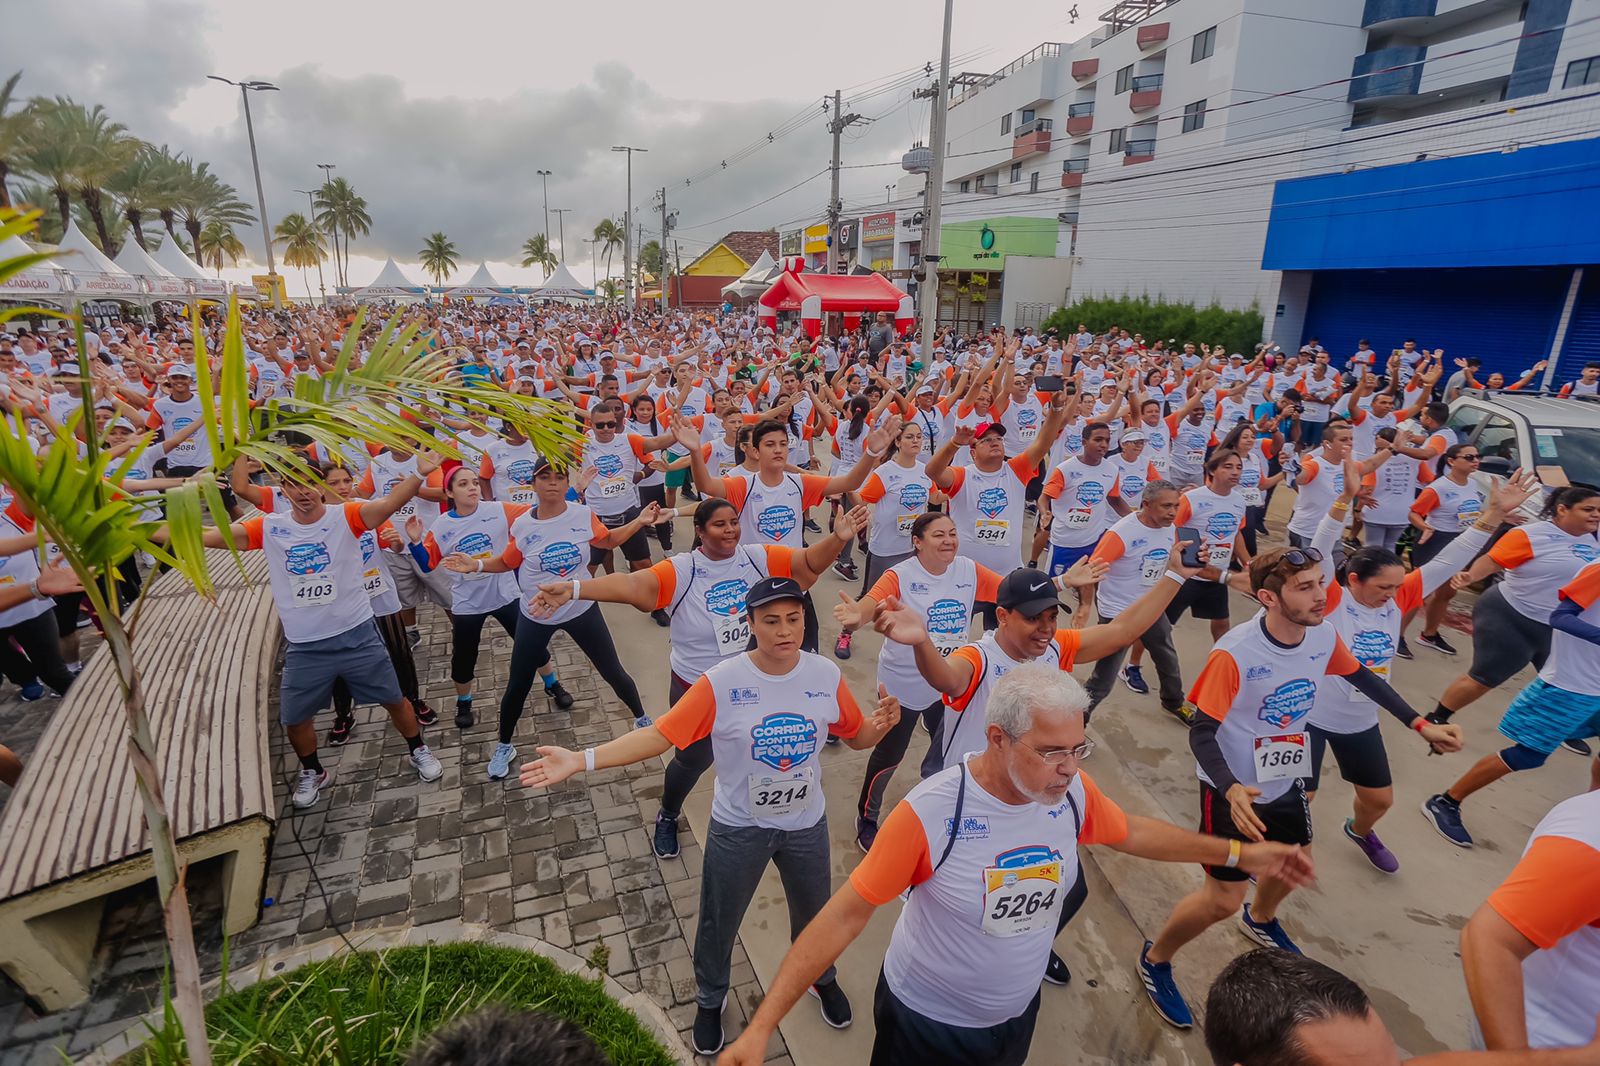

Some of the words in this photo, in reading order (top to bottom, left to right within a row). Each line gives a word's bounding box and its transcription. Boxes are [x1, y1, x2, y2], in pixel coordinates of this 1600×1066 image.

[604, 482, 626, 495] 5292
[512, 492, 533, 501] 5511
[1069, 515, 1090, 523] 1344
[759, 520, 795, 532] FOME
[977, 529, 1006, 539] 5341
[540, 545, 579, 559] CORRIDA
[543, 553, 574, 563] CONTRA
[542, 554, 580, 571] FOME
[296, 584, 332, 599] 4103
[705, 582, 747, 598] CORRIDA
[928, 604, 966, 615] CORRIDA
[931, 613, 960, 621] CONTRA
[928, 618, 966, 631] FOME
[753, 722, 815, 738] CORRIDA
[757, 735, 806, 746] CONTRA
[753, 741, 816, 759] FOME
[1260, 749, 1304, 768] 1366
[755, 784, 808, 806] 3214
[1039, 866, 1053, 877] 5K
[991, 887, 1058, 921] 5264
